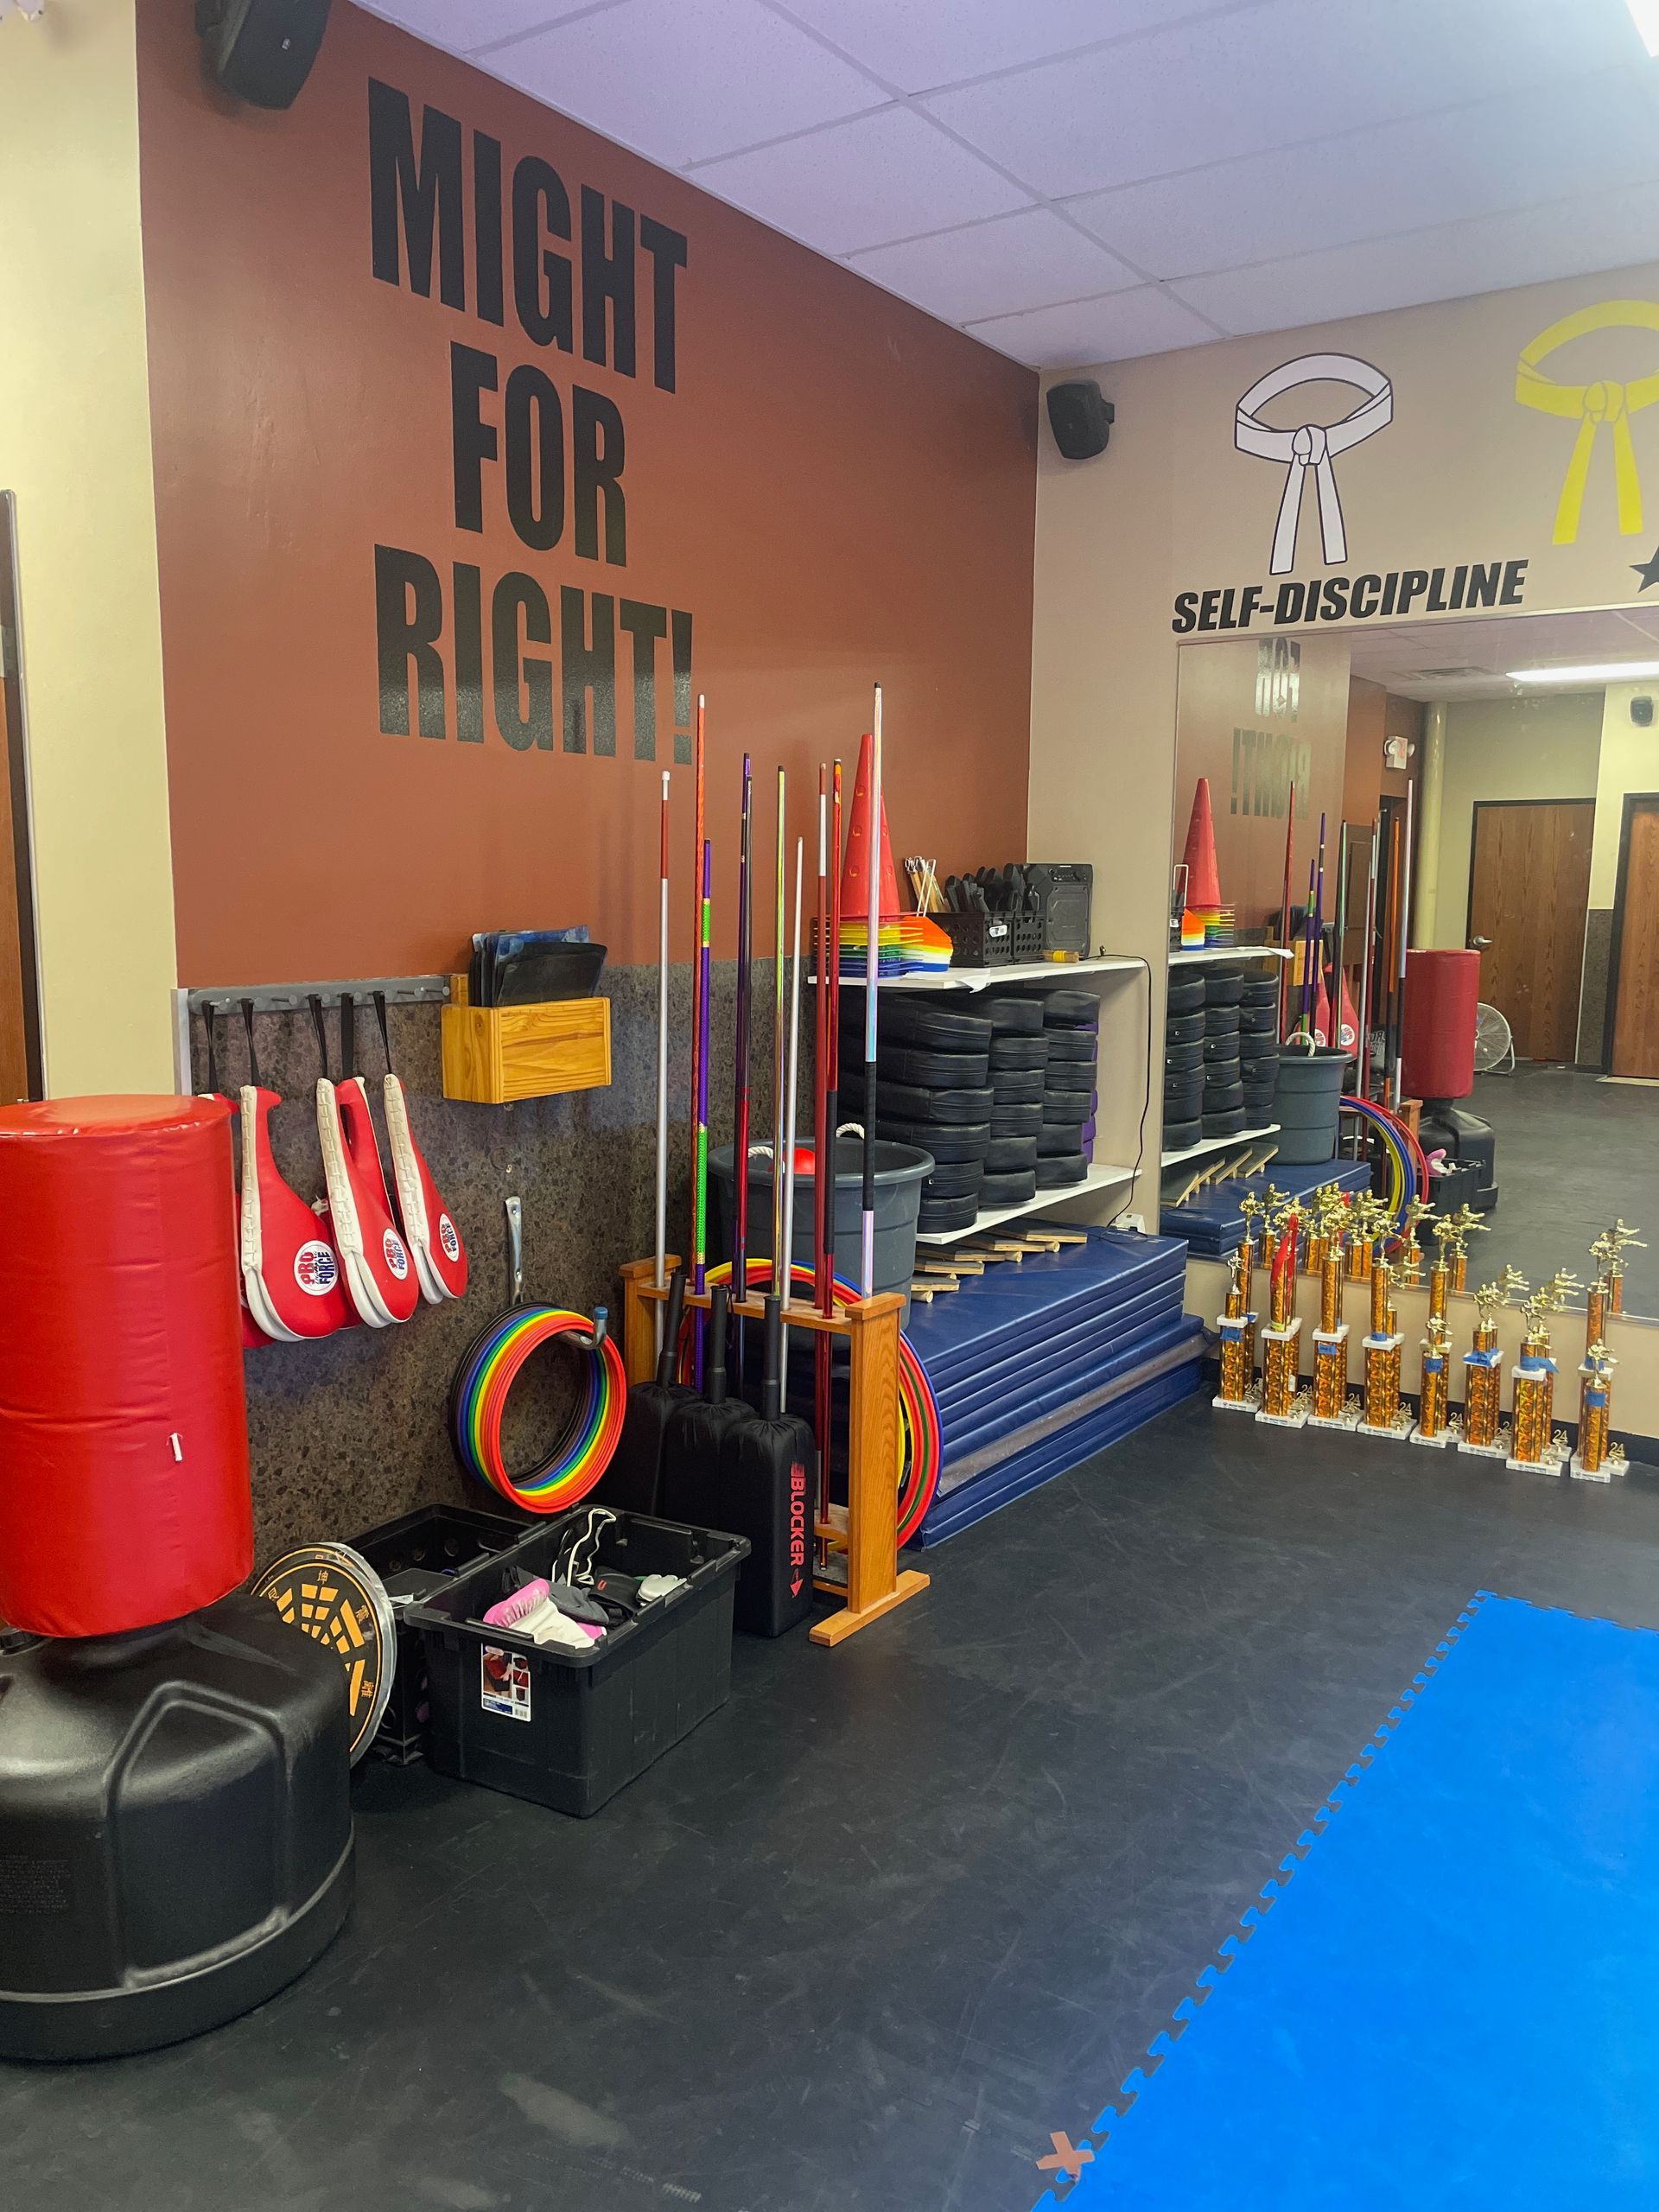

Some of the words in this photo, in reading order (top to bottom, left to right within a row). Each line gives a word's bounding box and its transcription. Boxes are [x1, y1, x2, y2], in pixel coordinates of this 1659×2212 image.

[368, 76, 688, 395] MIGHT
[450, 340, 626, 568] FOR
[1172, 559, 1529, 633] SELF-DISCIPLINE
[374, 543, 693, 766] RIGHT!
[385, 1238, 397, 1268] PRO
[392, 1240, 405, 1270] FORCE
[442, 1224, 452, 1253] PRO
[298, 1252, 315, 1285] PRO
[317, 1251, 335, 1285] FORCE
[790, 1477, 805, 1567] BLOCKER
